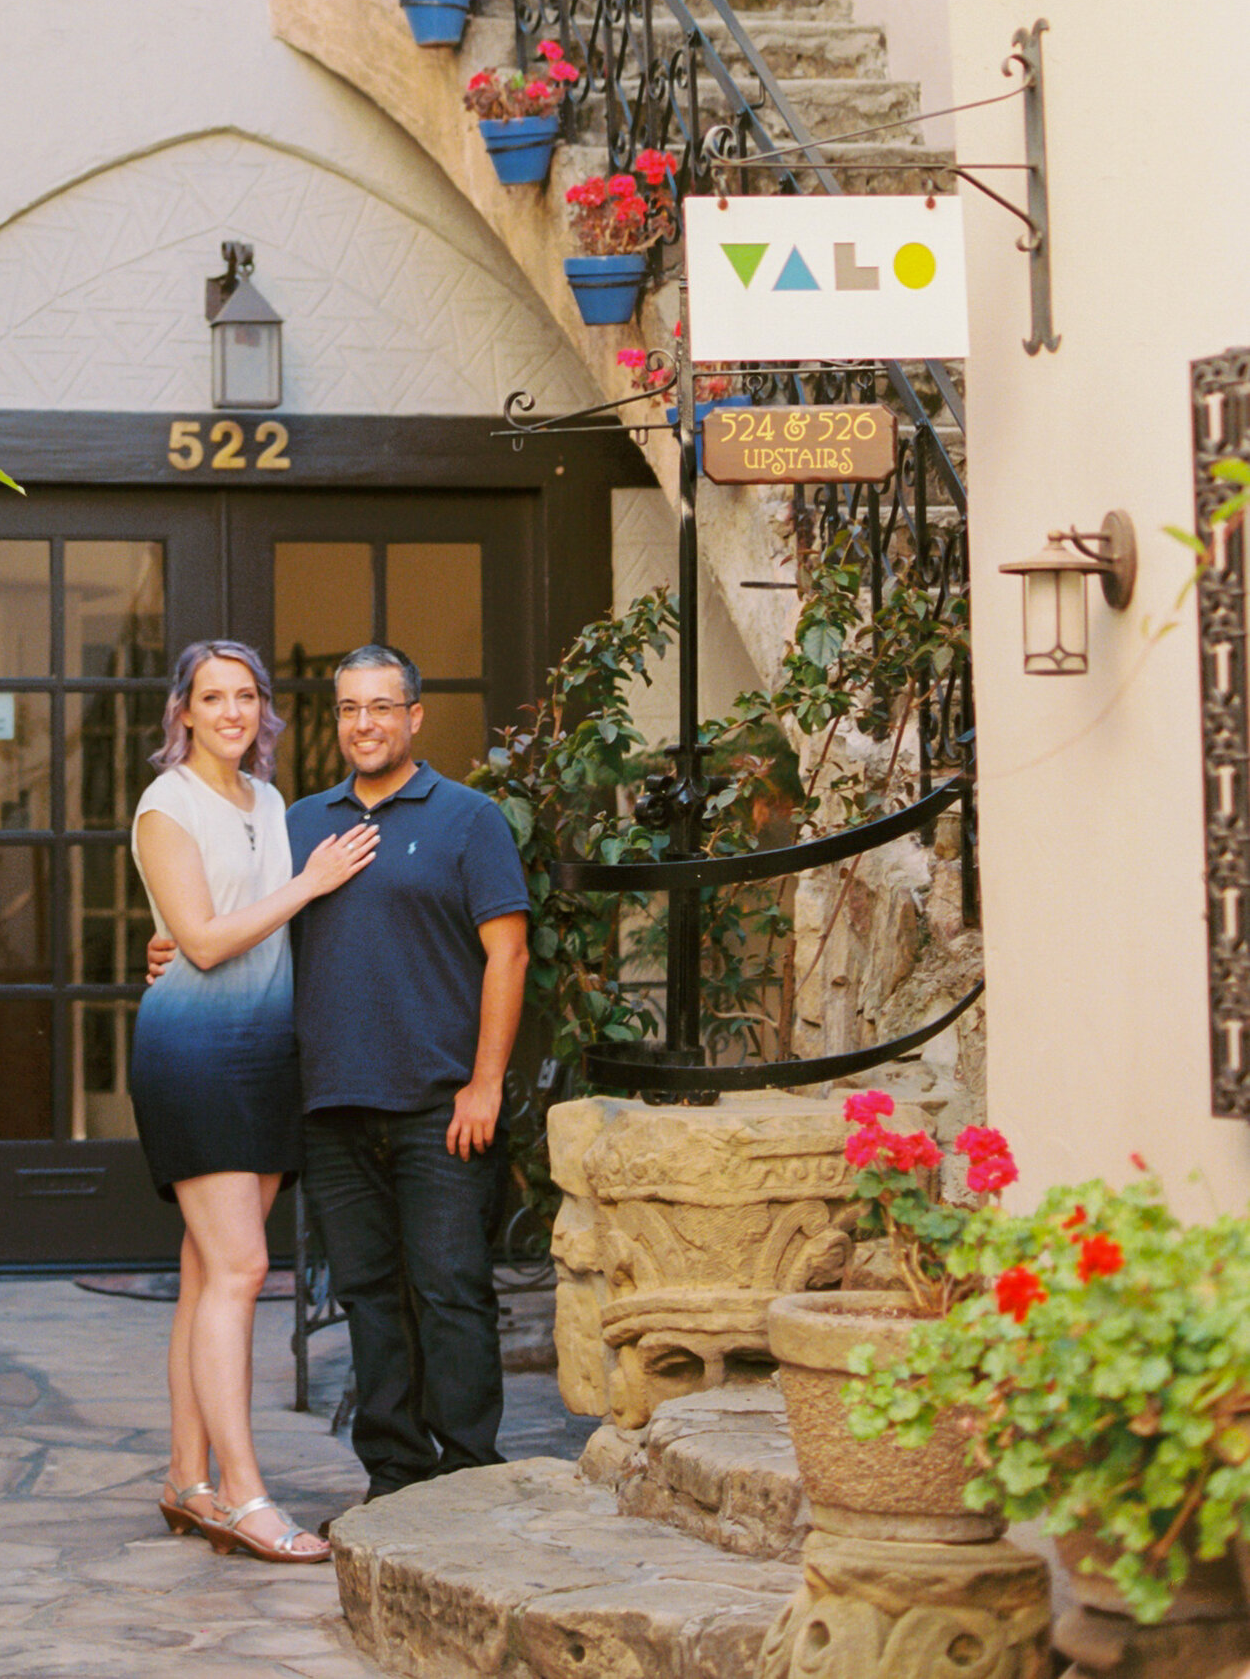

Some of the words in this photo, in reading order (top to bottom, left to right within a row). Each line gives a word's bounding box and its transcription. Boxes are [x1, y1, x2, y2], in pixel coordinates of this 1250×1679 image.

[718, 241, 938, 292] VALO
[167, 421, 292, 471] 522
[720, 413, 775, 442] 524
[783, 412, 810, 442] &
[818, 412, 877, 442] 526
[743, 447, 854, 476] UPSTAIRS
